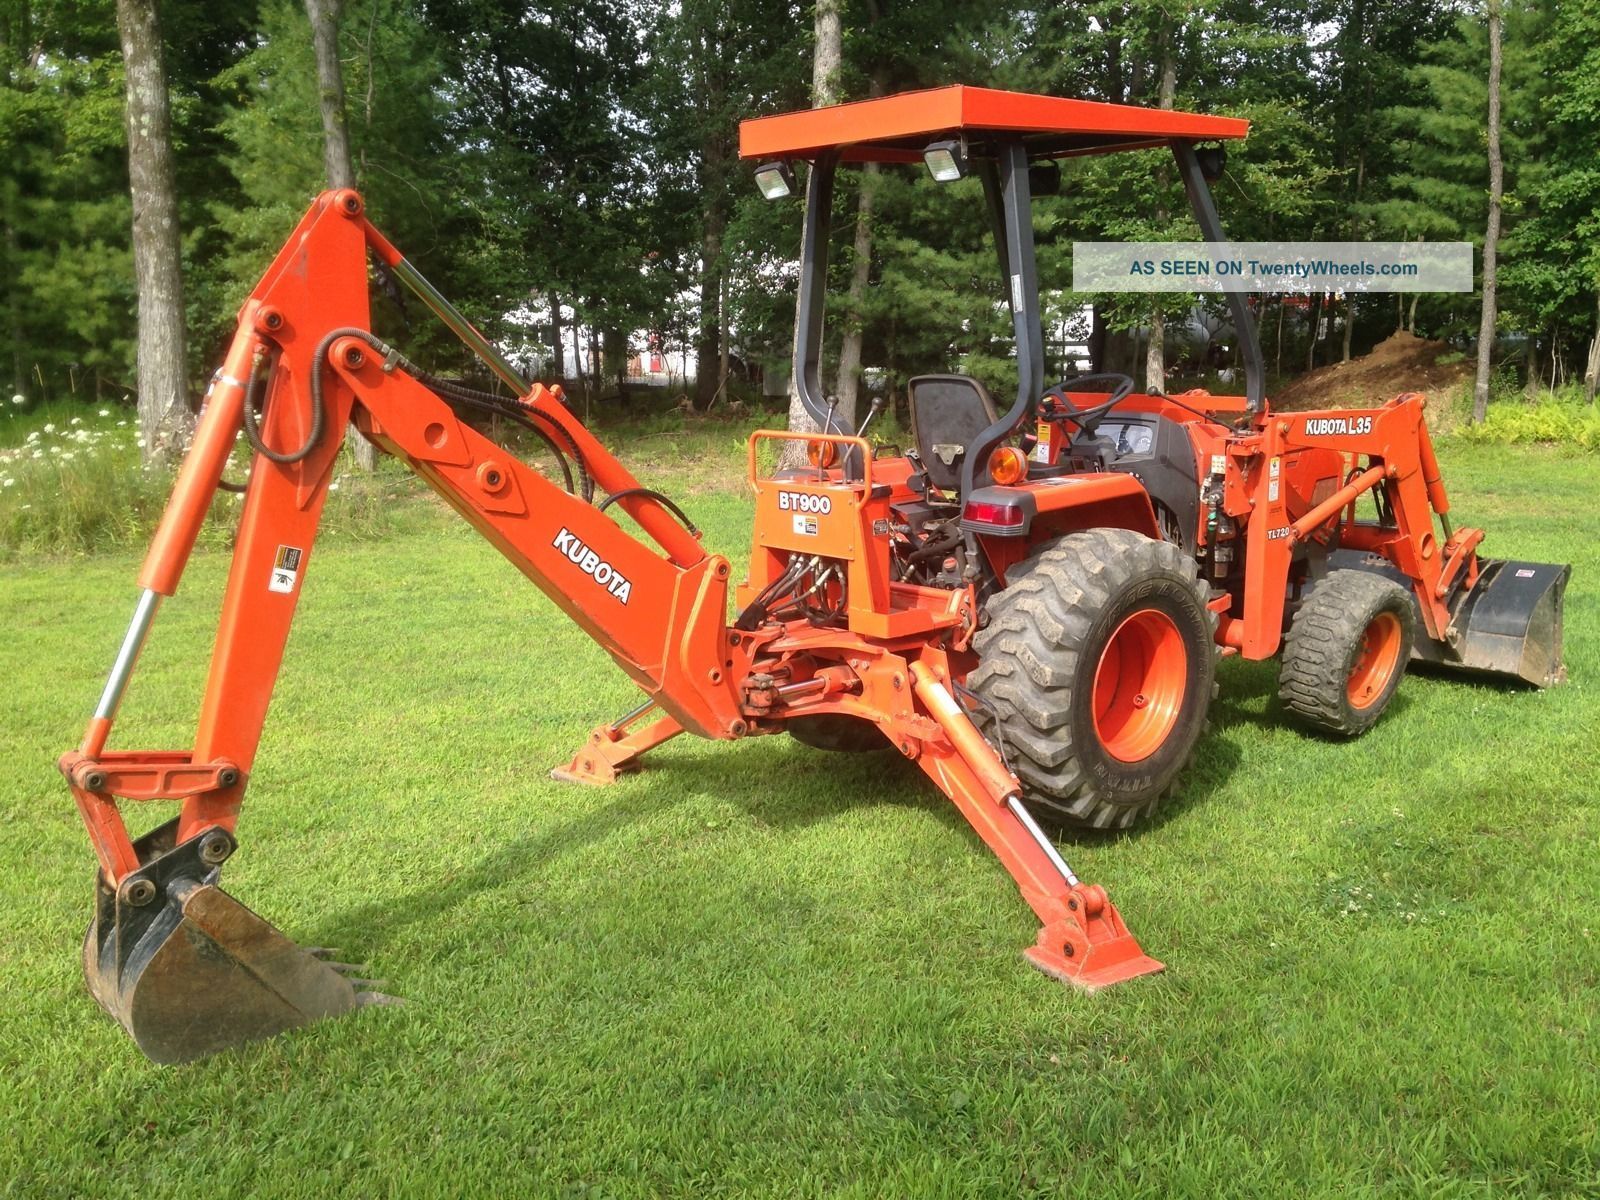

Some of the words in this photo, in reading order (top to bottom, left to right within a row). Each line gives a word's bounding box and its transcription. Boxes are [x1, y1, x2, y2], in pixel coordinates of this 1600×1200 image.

[1305, 418, 1347, 436] KUBOTA
[1348, 416, 1372, 435] L35
[778, 490, 831, 516] BT900
[1267, 526, 1290, 540] TL720
[552, 526, 633, 606] KUBOTA
